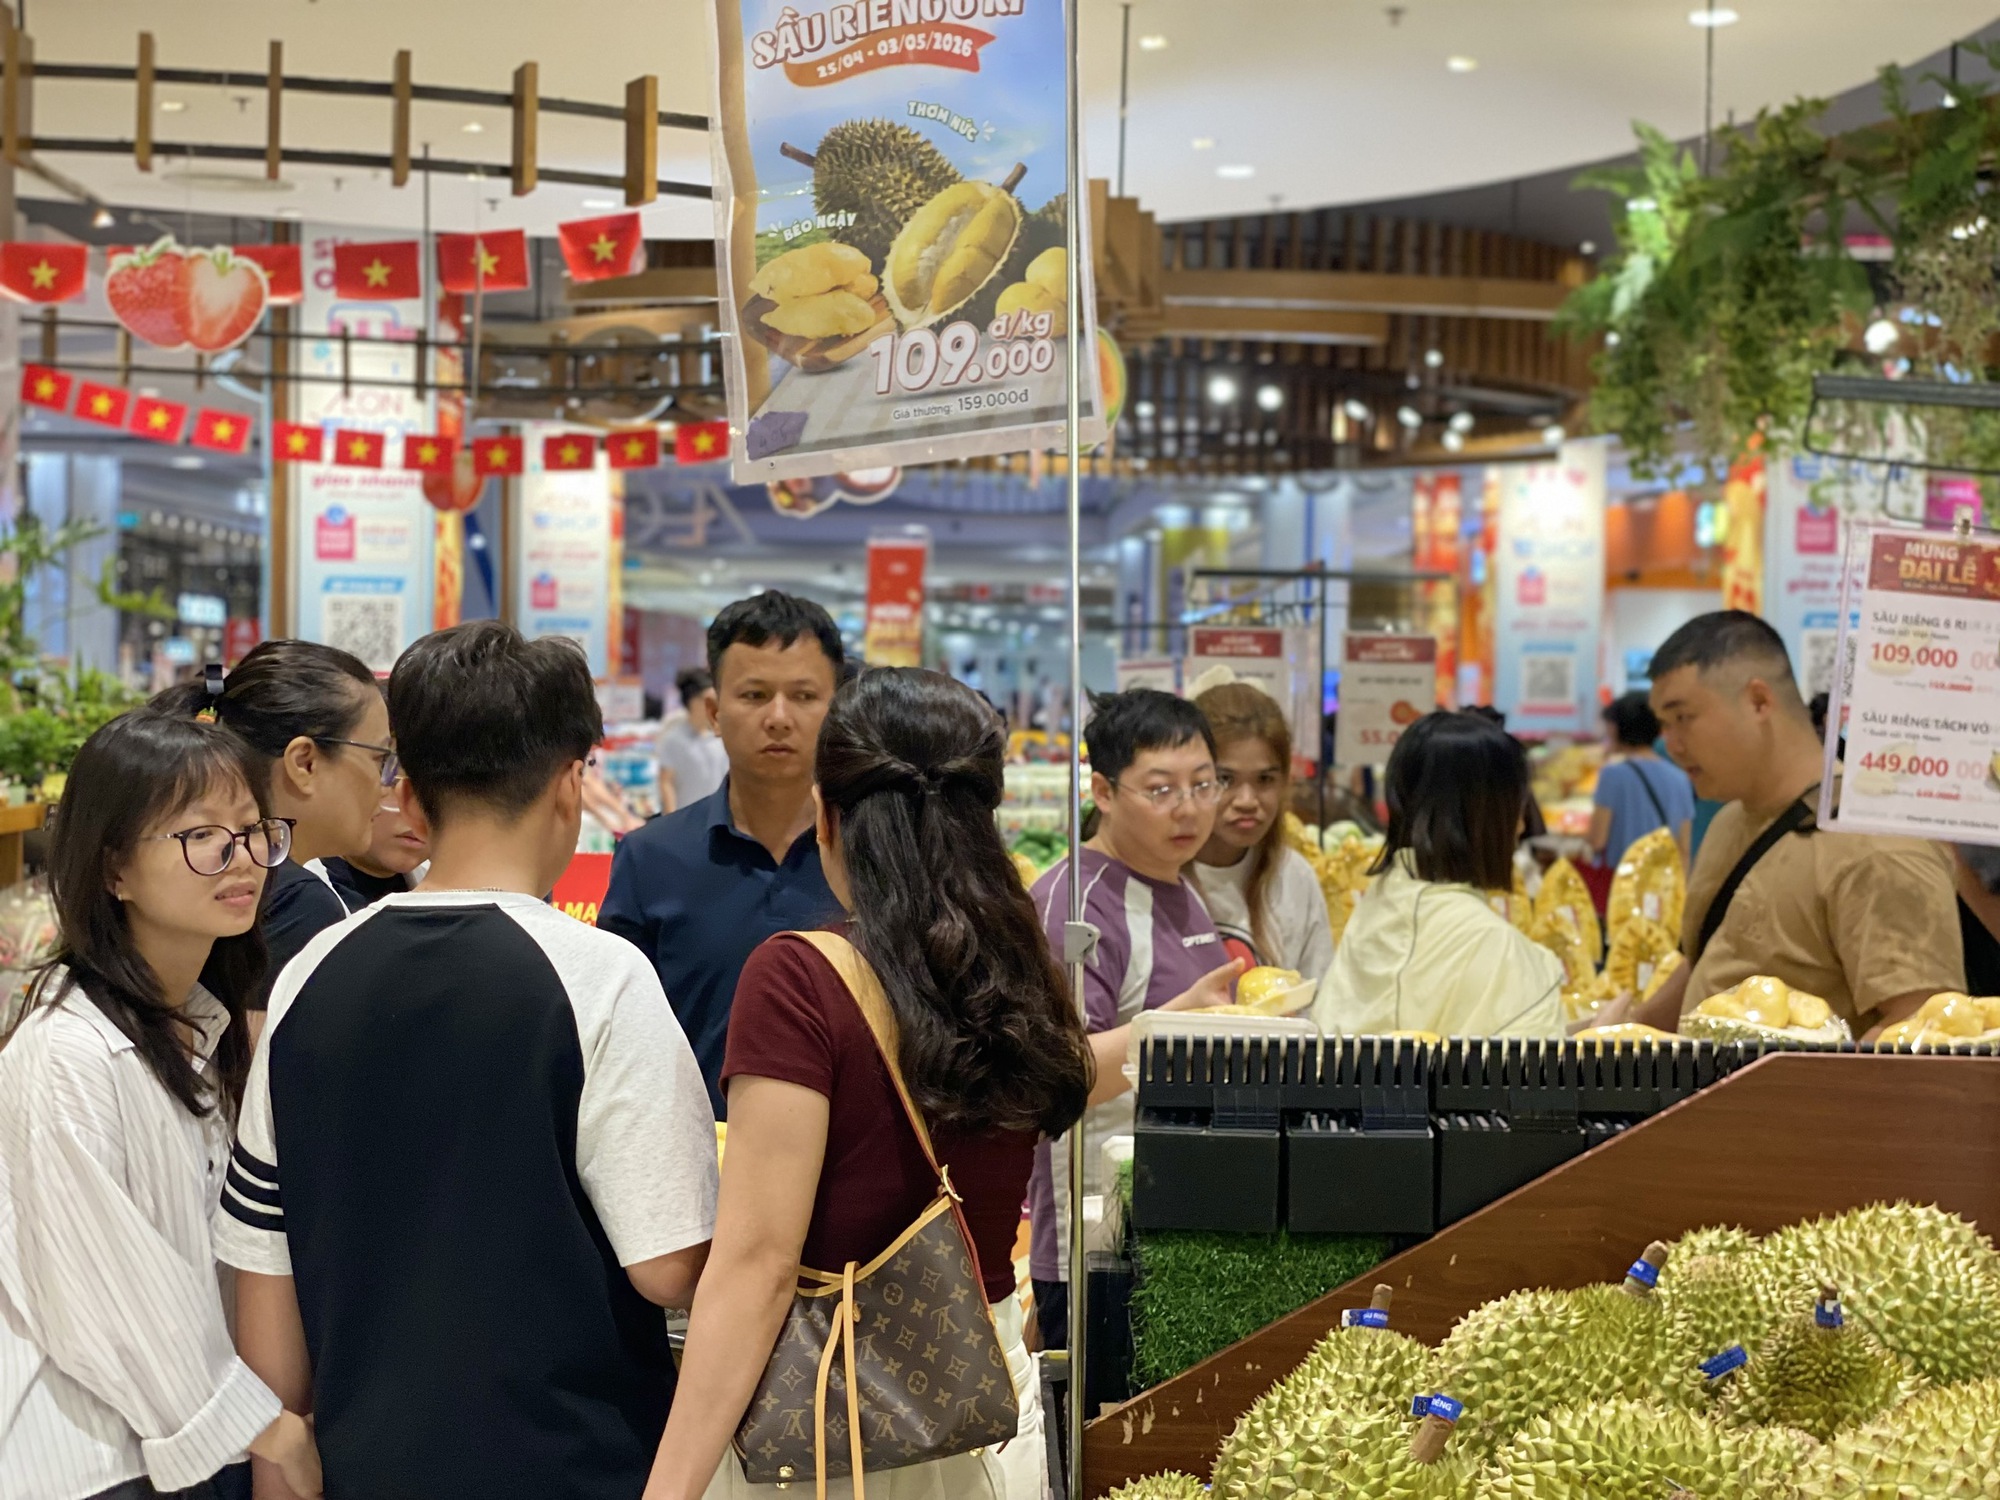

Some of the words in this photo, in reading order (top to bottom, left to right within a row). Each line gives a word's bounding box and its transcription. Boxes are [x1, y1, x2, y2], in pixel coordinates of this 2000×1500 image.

[817, 50, 865, 78] 25/04
[876, 31, 974, 58] 03/05/2026
[907, 101, 950, 125] THƠM
[783, 220, 813, 241] BÉO
[816, 209, 857, 230] NGẬY
[893, 407, 911, 420] Giá
[957, 388, 1030, 411] 159.000đ
[1871, 642, 1958, 668] 109.000
[1859, 751, 1949, 777] 449.000
